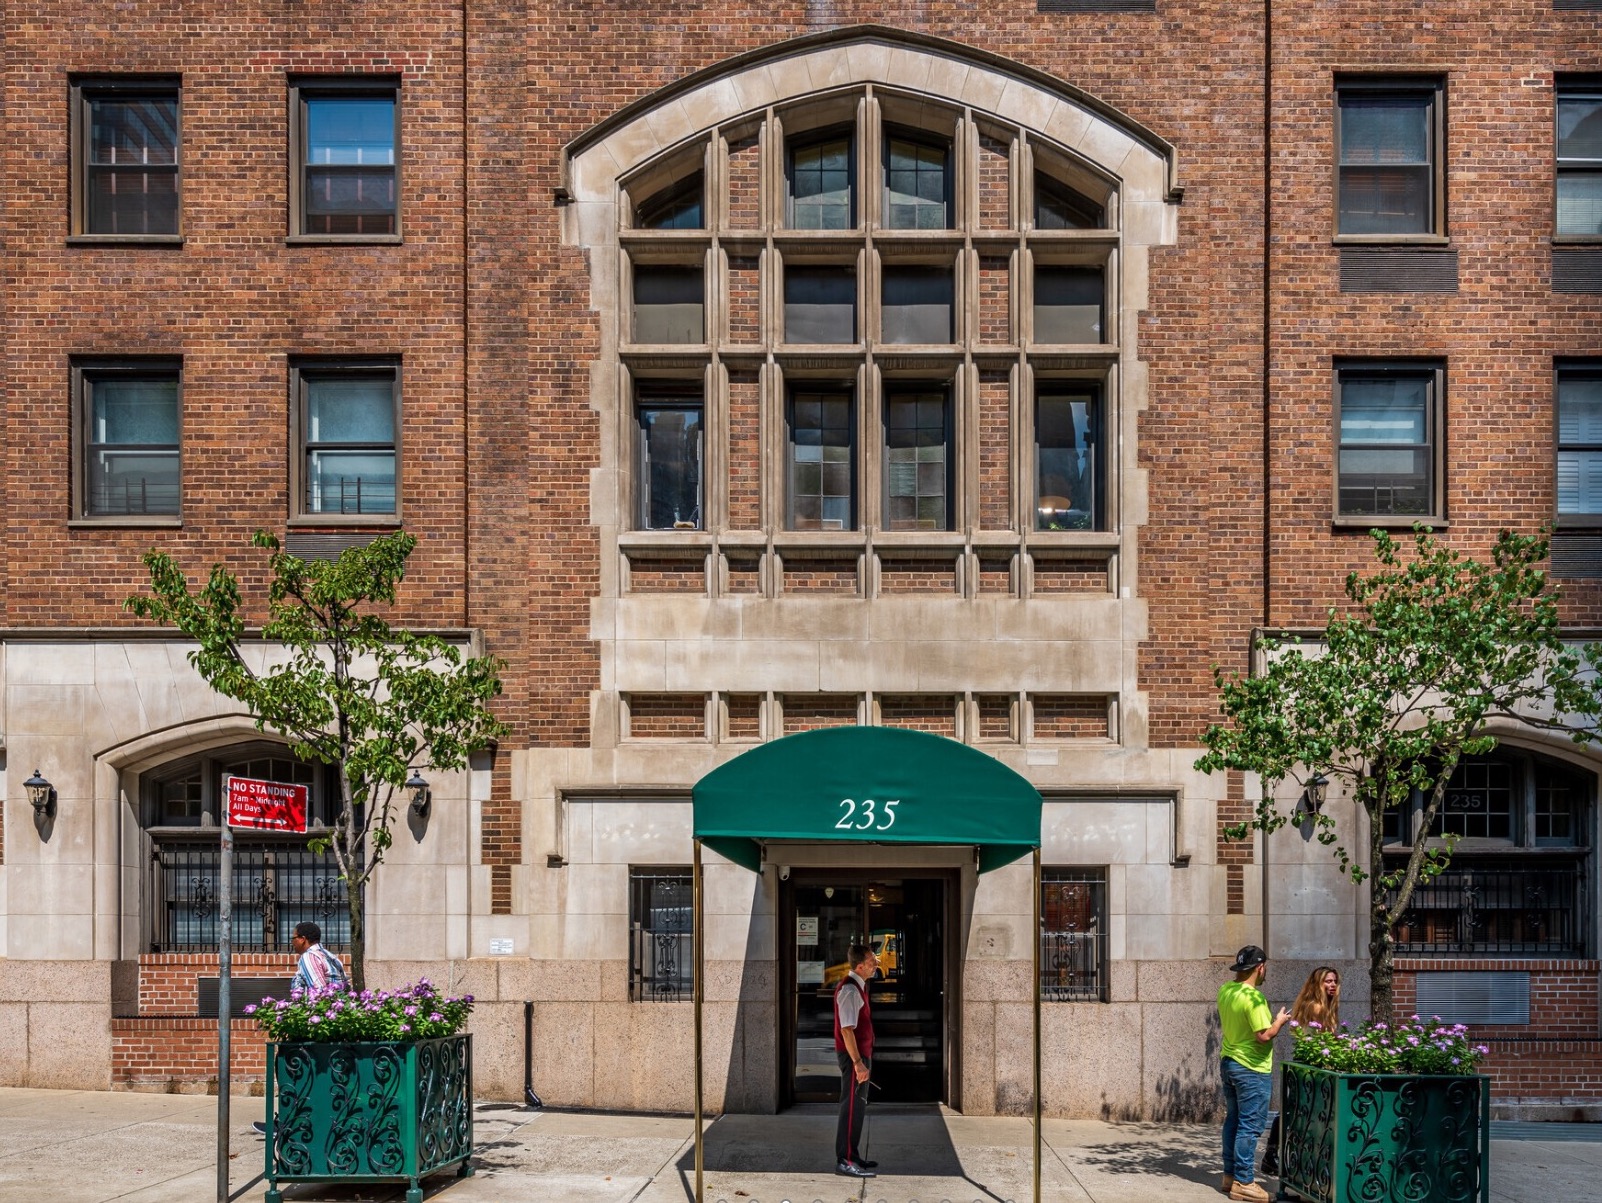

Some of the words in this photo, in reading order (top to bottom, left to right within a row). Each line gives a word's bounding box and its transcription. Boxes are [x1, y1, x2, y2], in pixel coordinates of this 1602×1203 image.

[232, 782, 247, 792] NO
[249, 784, 296, 798] STANDING
[232, 803, 243, 811] All
[244, 804, 262, 813] Days
[233, 793, 249, 802] 7am
[255, 796, 286, 808] Midnight
[1450, 794, 1481, 809] 235
[834, 798, 901, 831] 235
